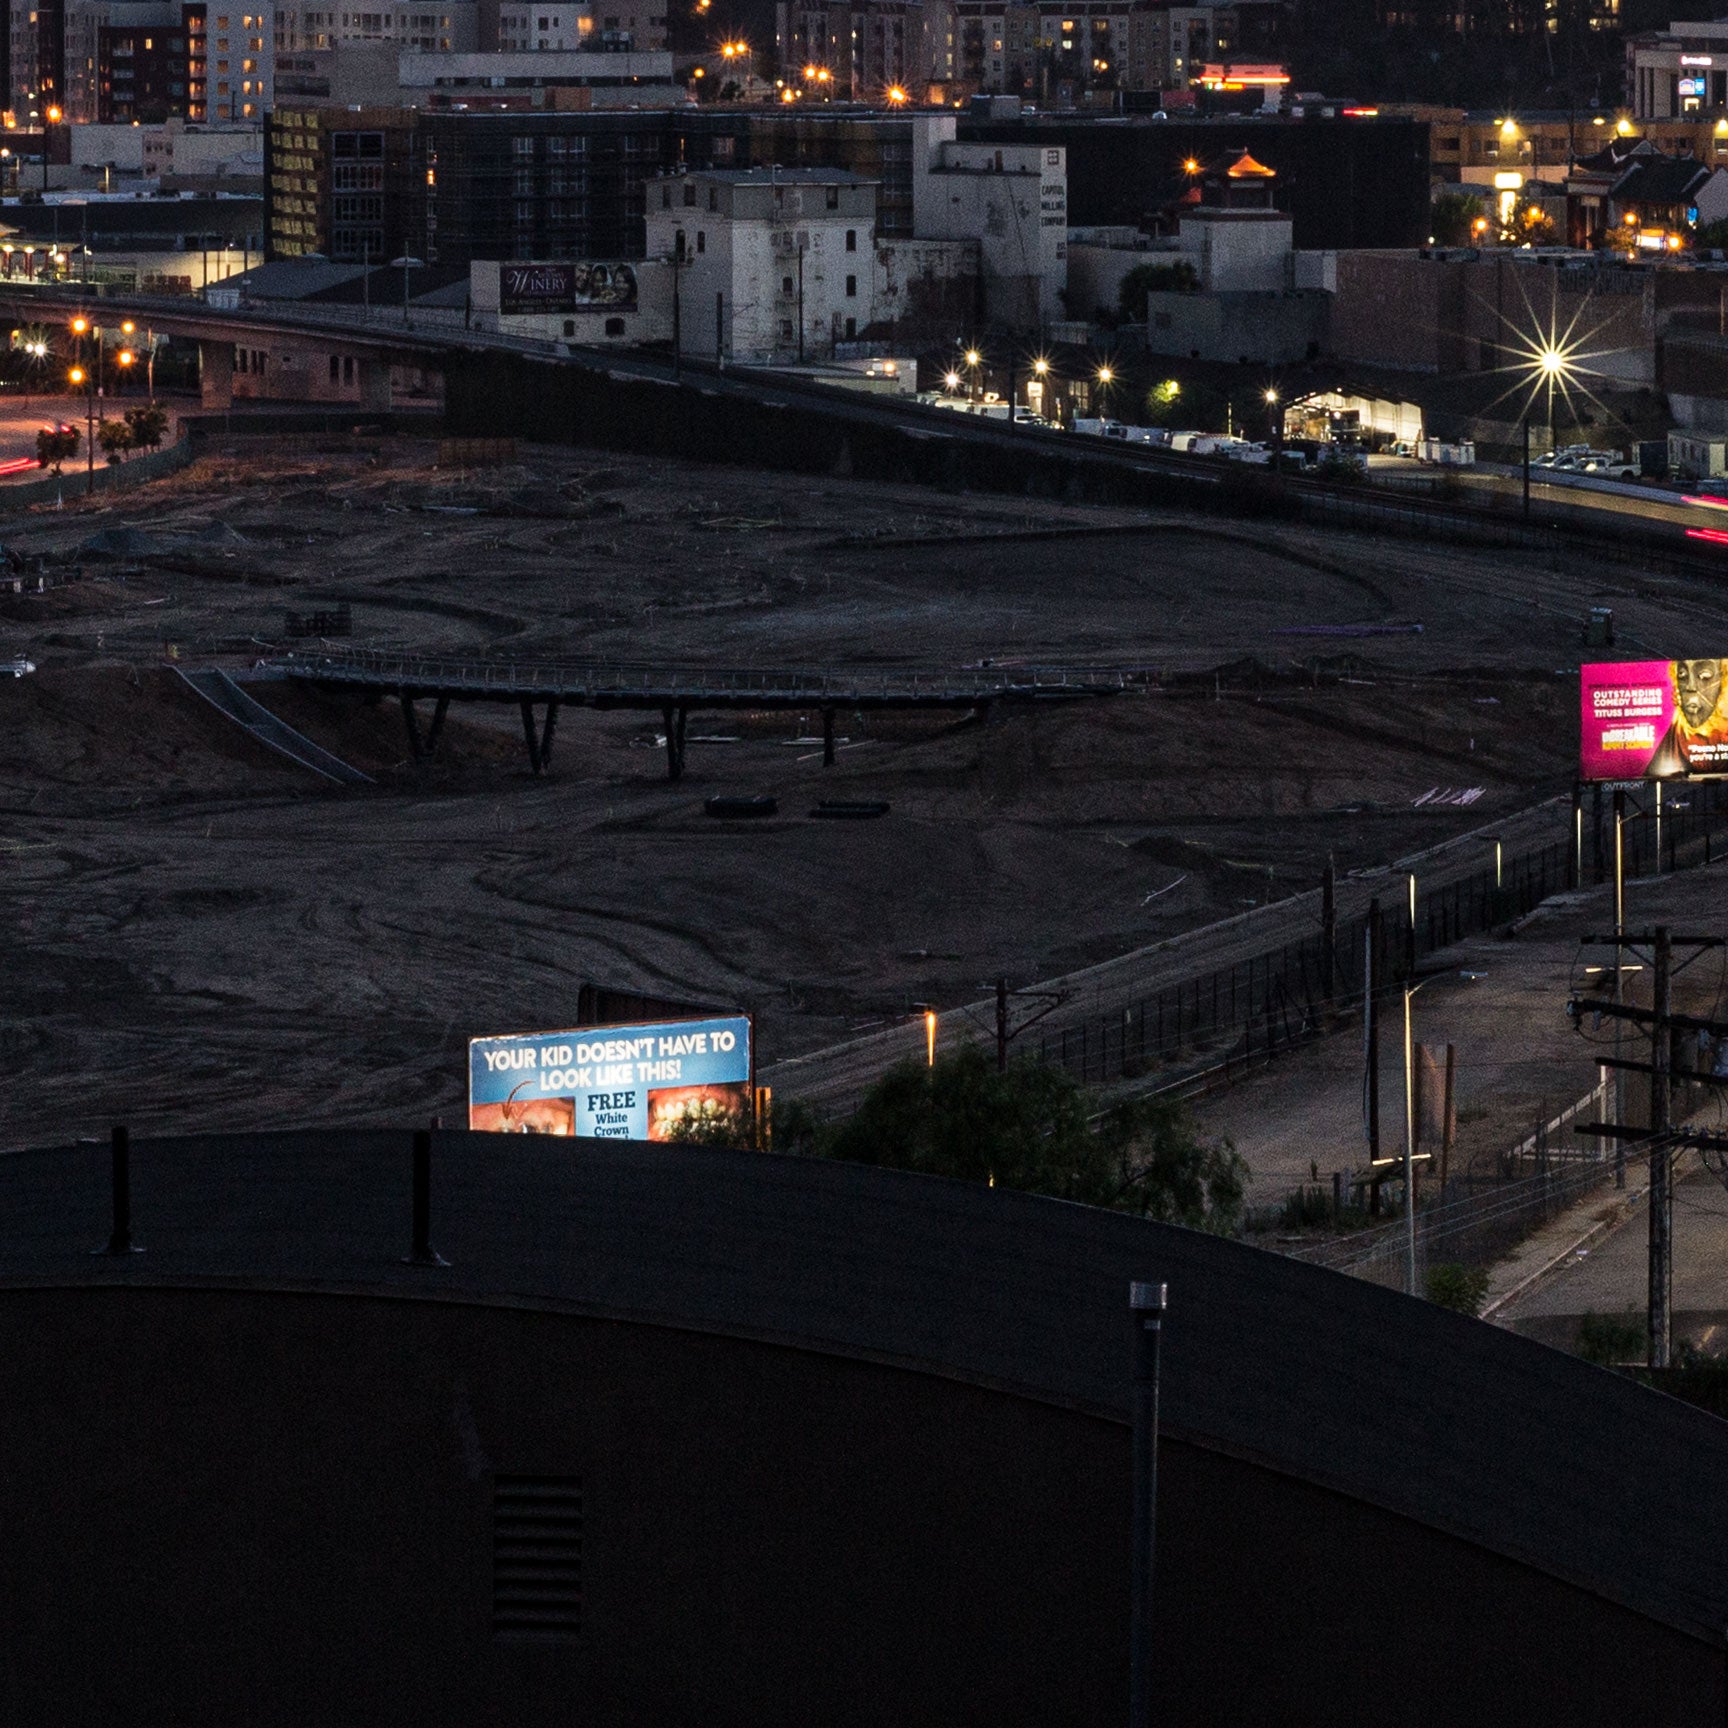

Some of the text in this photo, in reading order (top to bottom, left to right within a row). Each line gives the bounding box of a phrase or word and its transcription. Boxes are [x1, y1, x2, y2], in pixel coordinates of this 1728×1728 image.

[506, 270, 568, 294] WINERY
[1593, 688, 1662, 699] OUTSTANDING
[1593, 696, 1662, 707] COMEDY SERIES
[1594, 706, 1662, 718] TITUSS BURGESS
[1602, 780, 1645, 791] OUTFRONT
[485, 1031, 735, 1071] YOUR KID DOESN'T HAVE TO
[540, 1059, 682, 1091] LOOK LIKE THIS!
[587, 1091, 636, 1112] FREE
[595, 1112, 628, 1125] White
[594, 1125, 629, 1137] Crown
